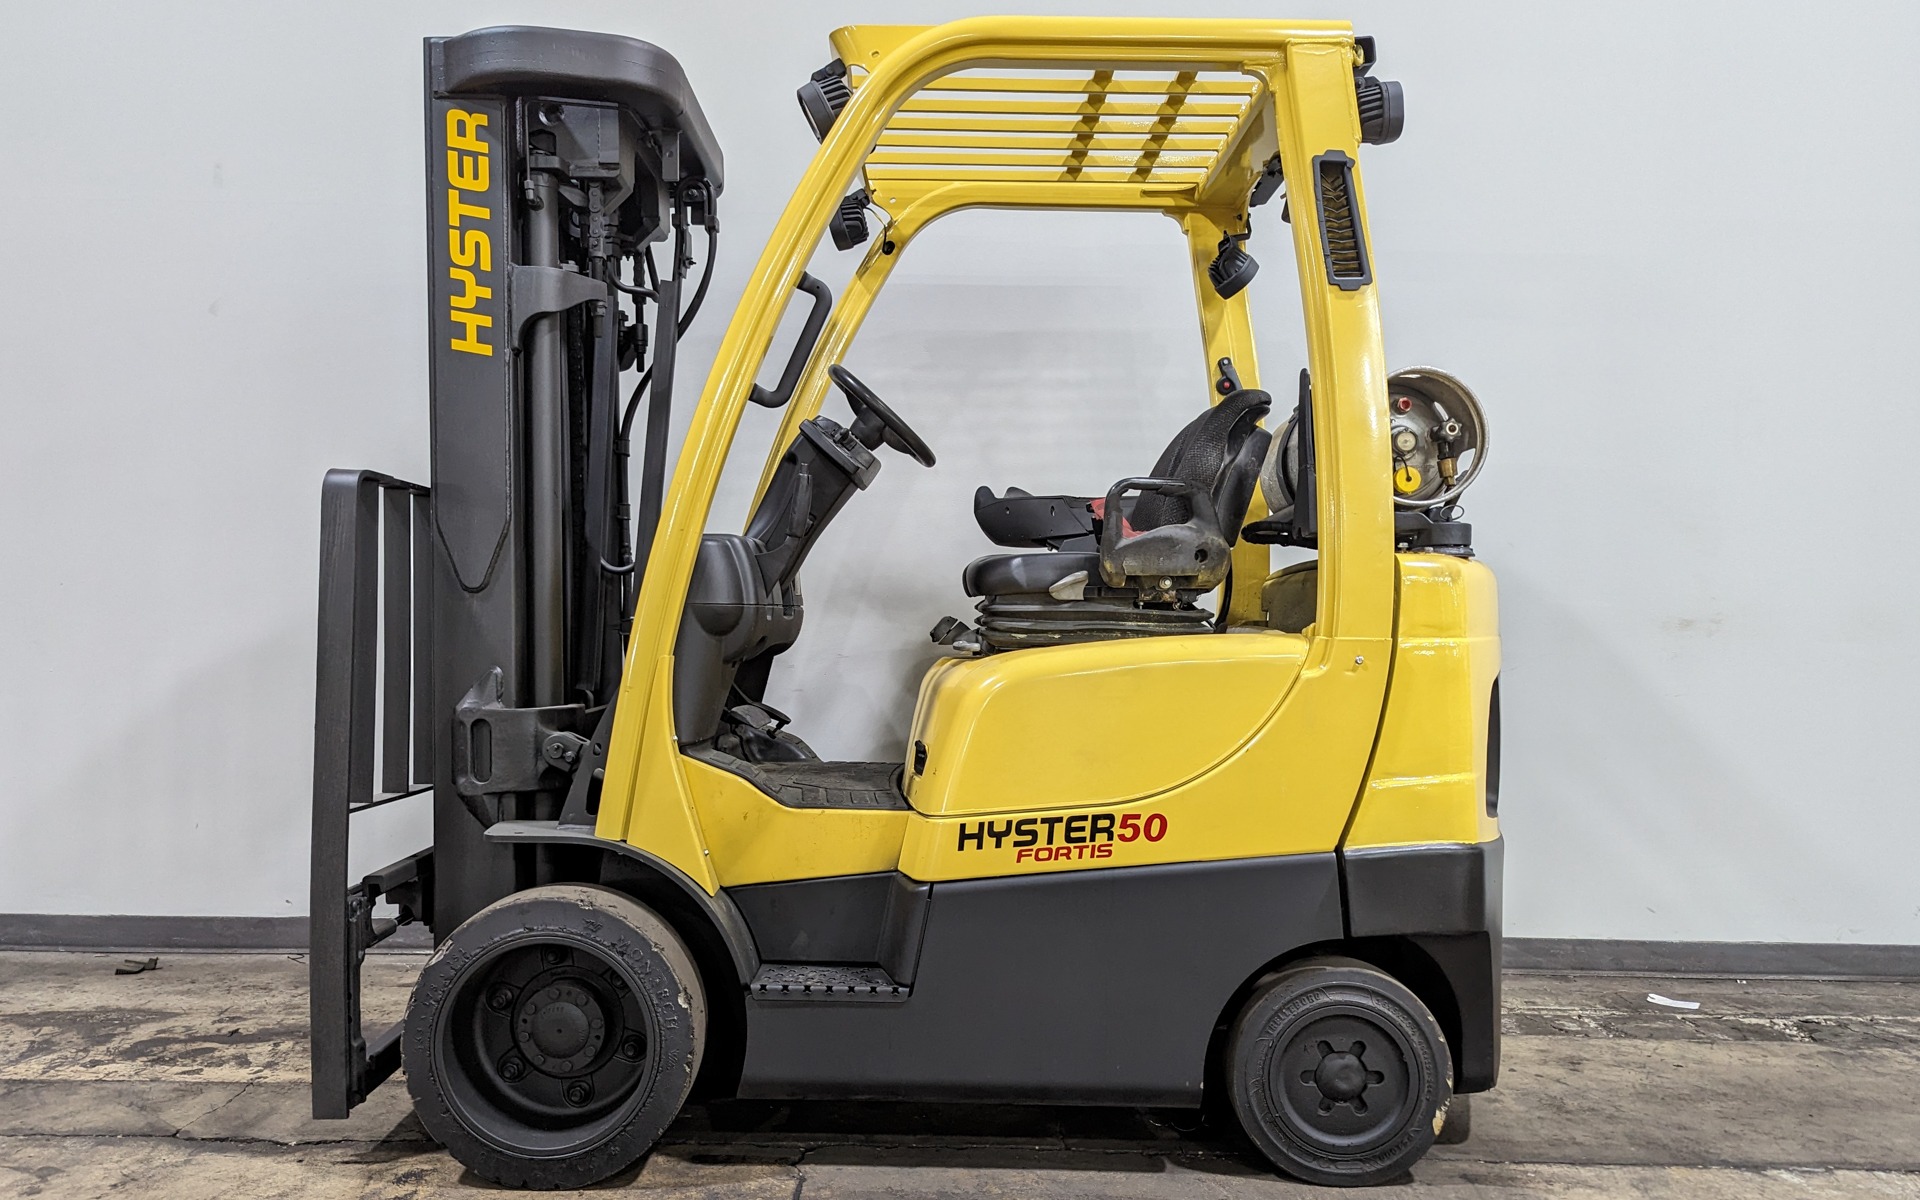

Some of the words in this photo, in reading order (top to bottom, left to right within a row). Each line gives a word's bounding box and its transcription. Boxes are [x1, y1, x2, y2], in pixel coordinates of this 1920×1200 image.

[446, 108, 493, 357] HYSTER
[957, 812, 1116, 852] HYSTER
[1116, 812, 1169, 843] 50
[1015, 843, 1114, 864] FORTIS
